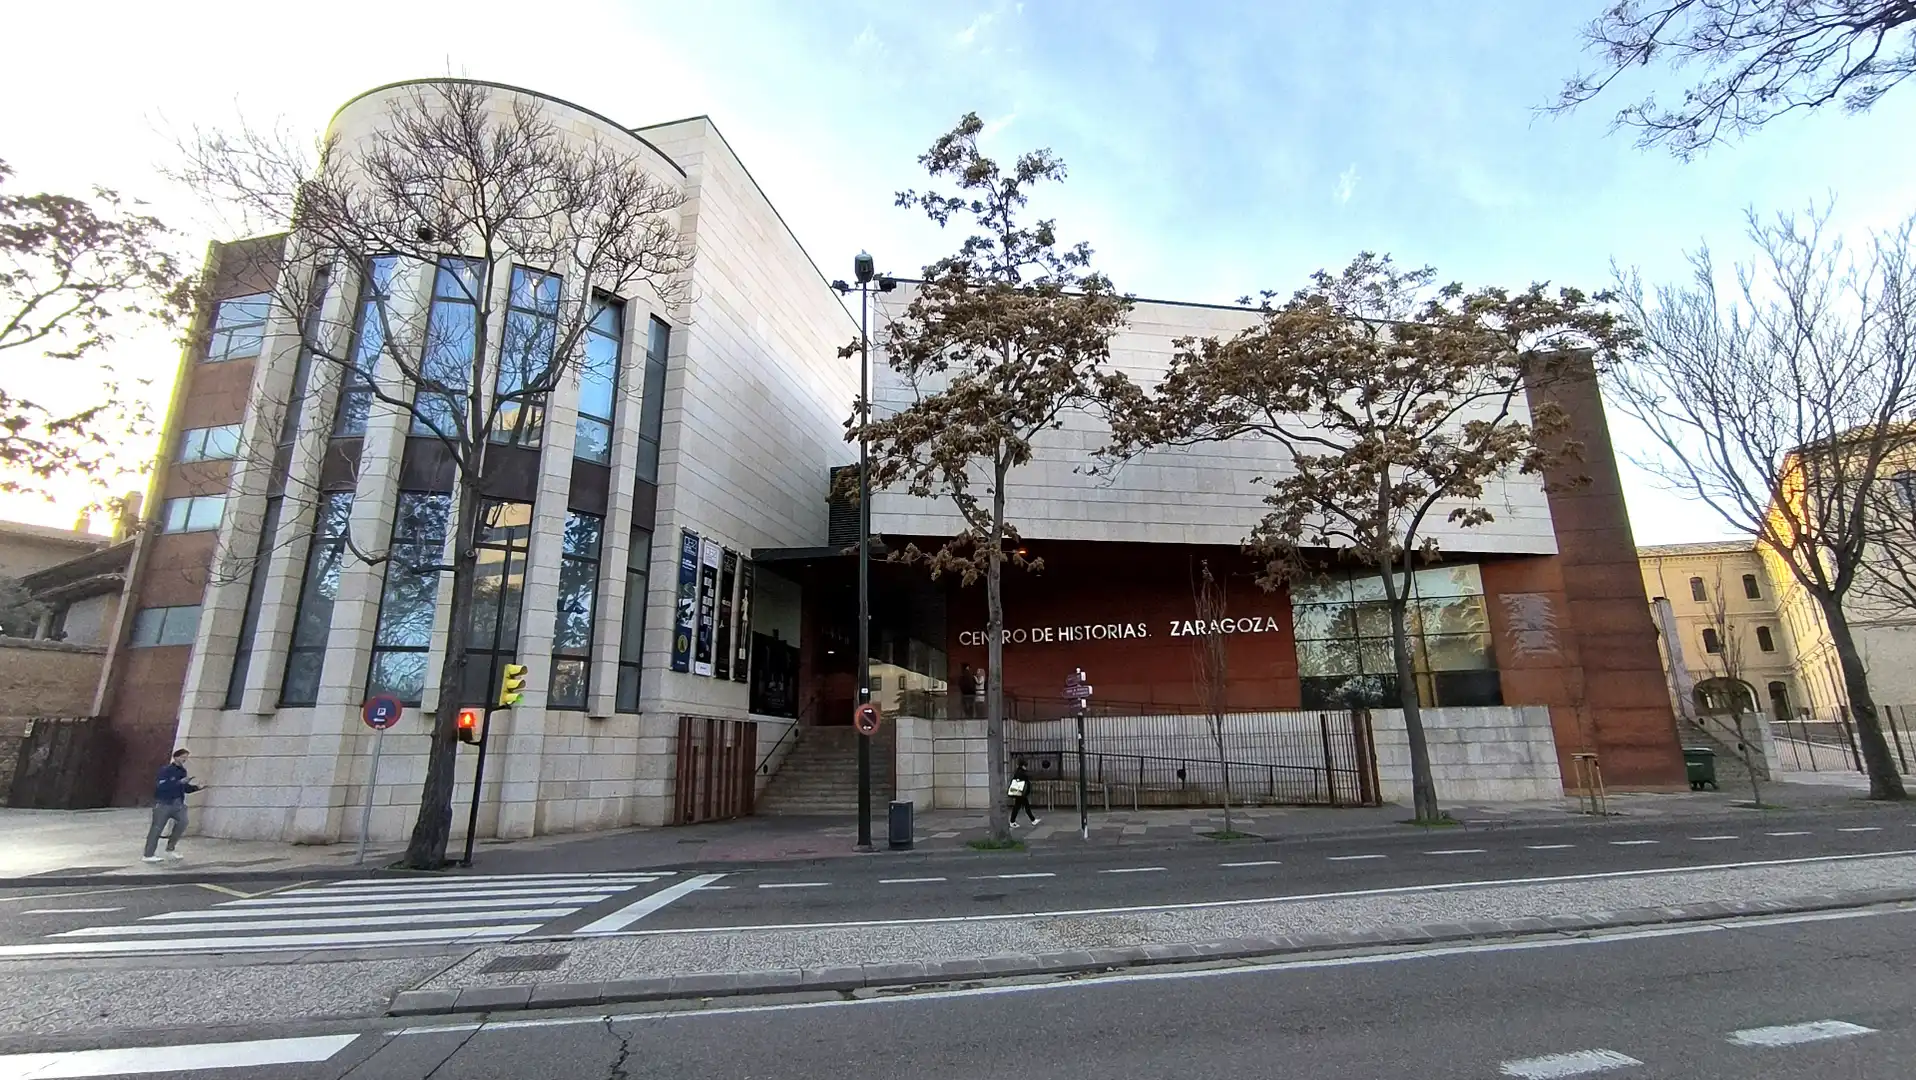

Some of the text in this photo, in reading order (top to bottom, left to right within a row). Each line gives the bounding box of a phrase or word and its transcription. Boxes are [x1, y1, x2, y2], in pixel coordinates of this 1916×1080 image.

[959, 616, 1279, 646] CENRO DE HISTORIAS. ZARAGOZA
